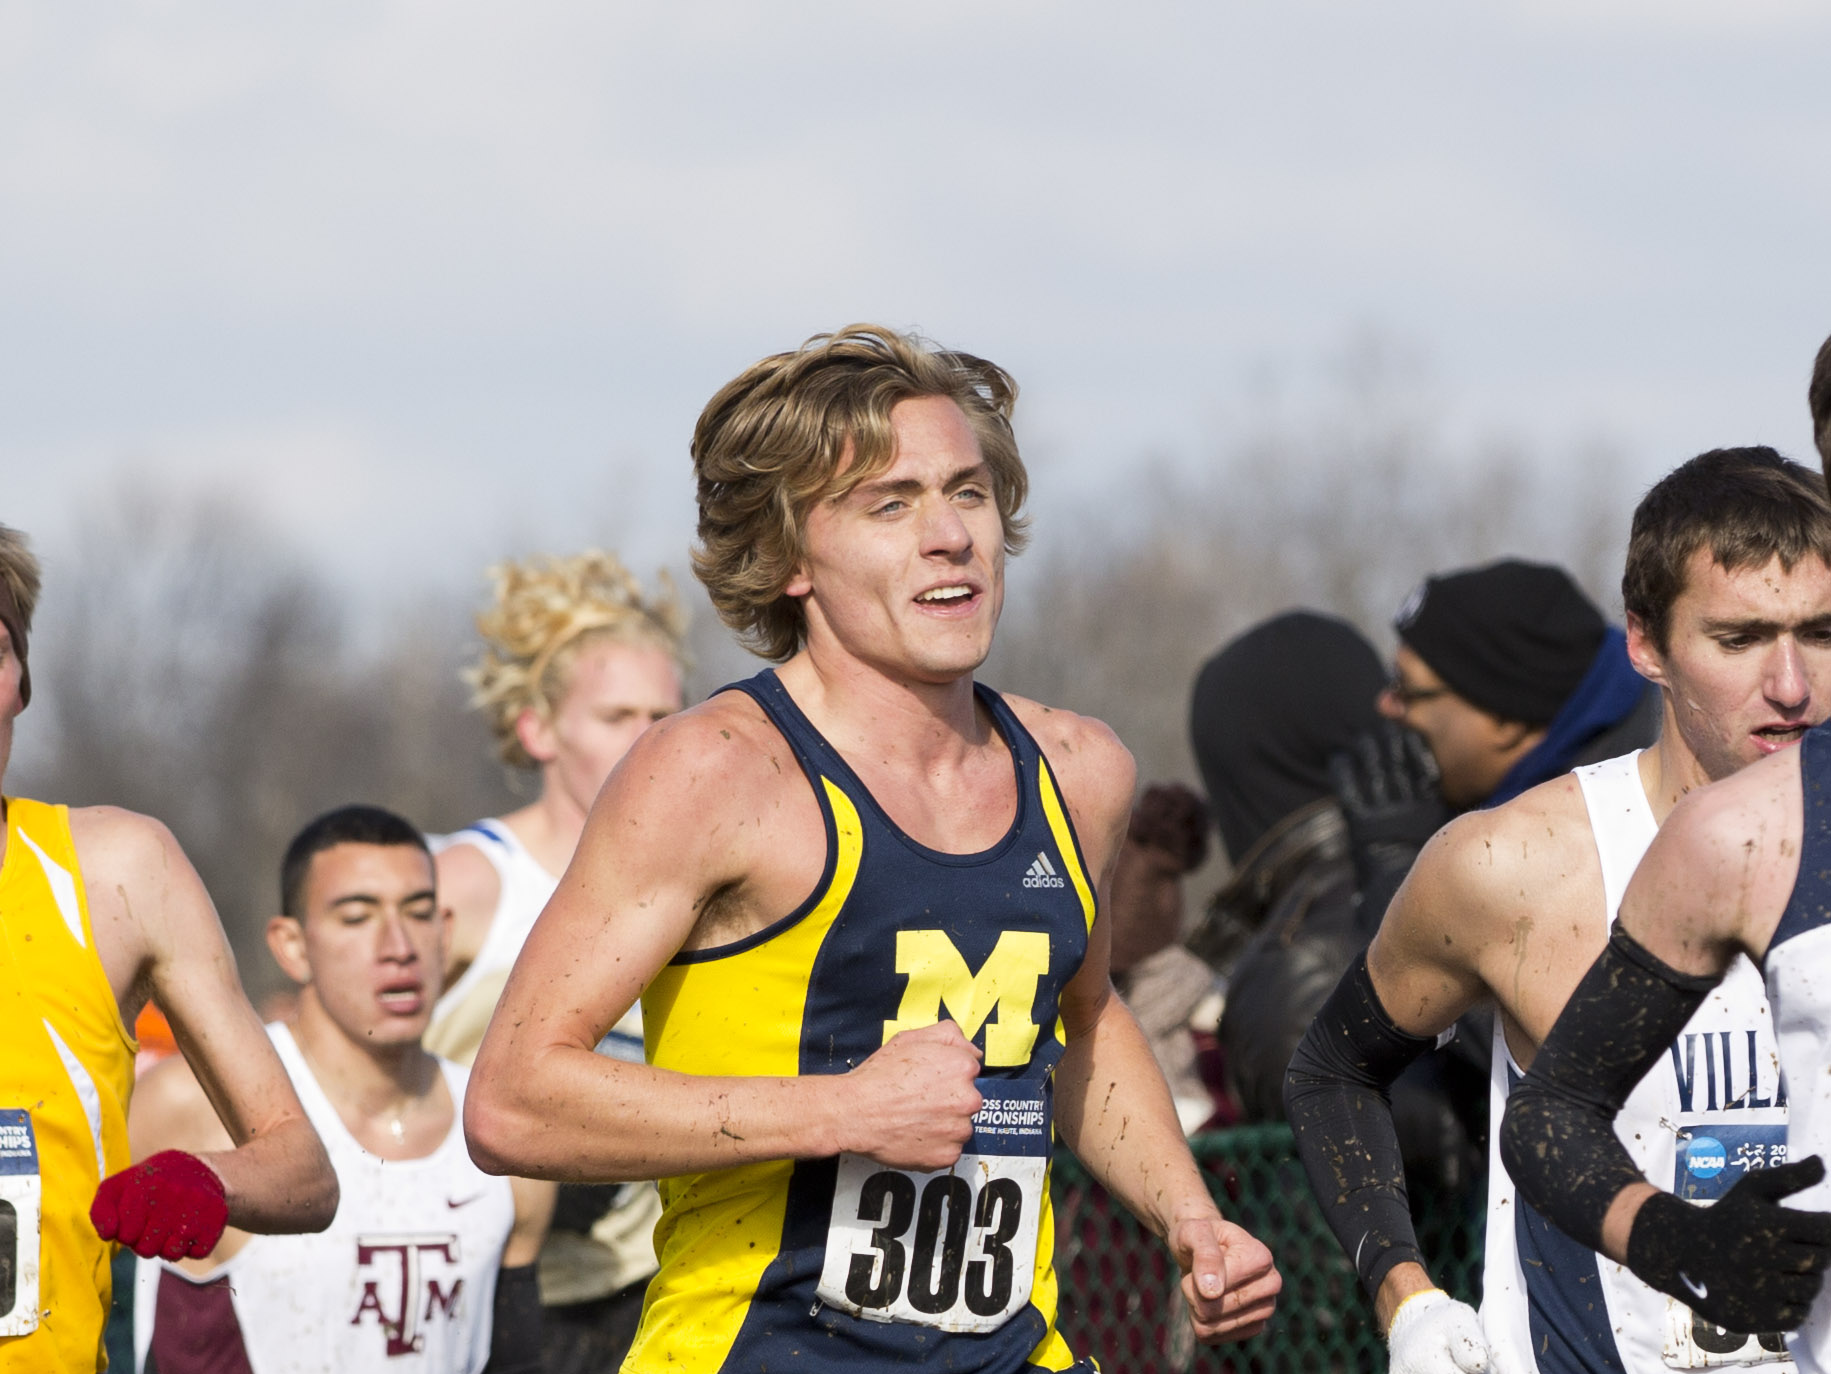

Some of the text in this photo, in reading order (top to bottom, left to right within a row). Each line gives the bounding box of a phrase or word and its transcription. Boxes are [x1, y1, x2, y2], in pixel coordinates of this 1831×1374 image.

[1022, 874, 1065, 888] adidas
[882, 929, 1050, 1067] M
[1002, 1100, 1045, 1112] COUNTRY
[1688, 1156, 1726, 1169] NCAA
[845, 1170, 1024, 1318] 303
